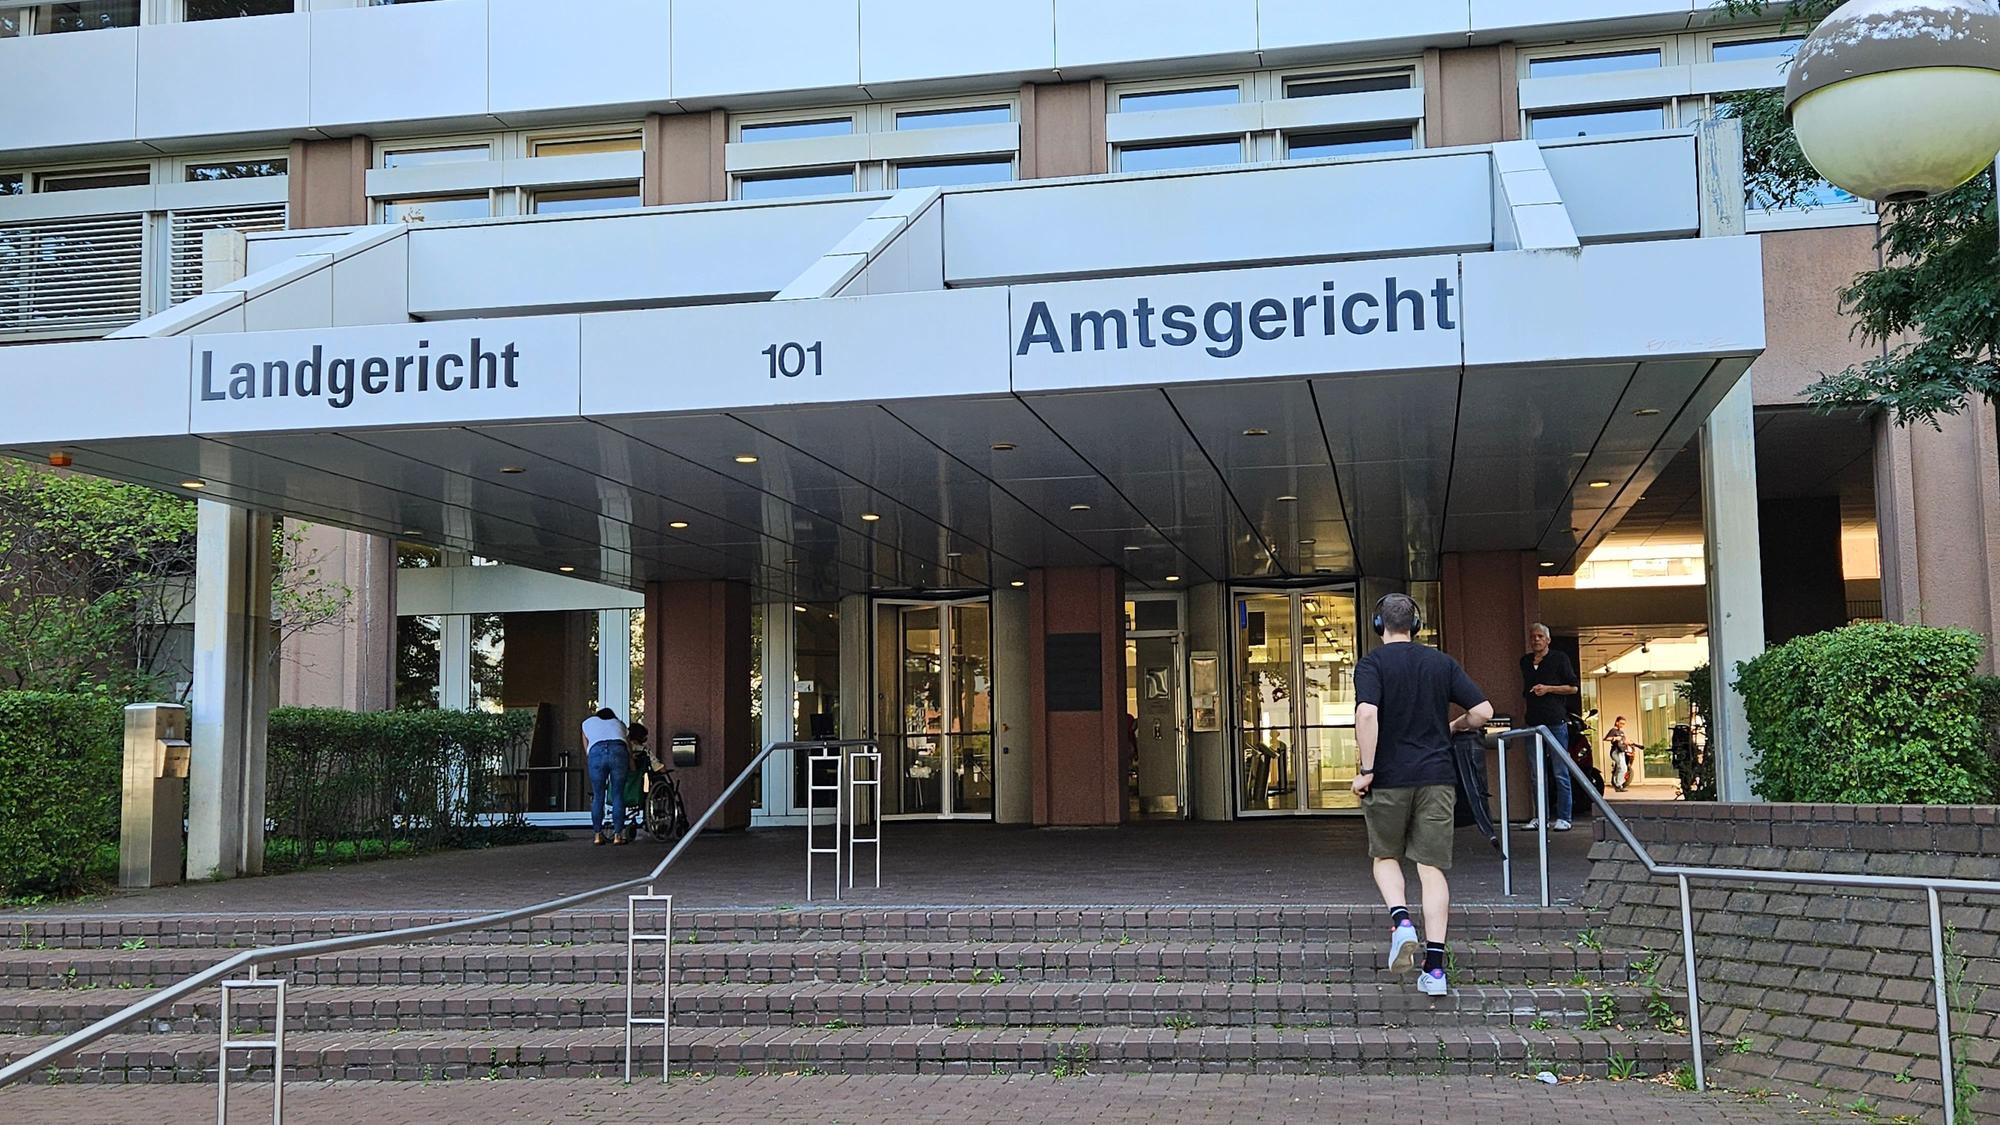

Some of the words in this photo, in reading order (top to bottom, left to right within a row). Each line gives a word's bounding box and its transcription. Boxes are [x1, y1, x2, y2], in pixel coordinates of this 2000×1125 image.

[1015, 276, 1456, 359] Amtsgericht
[201, 337, 520, 409] Landgericht
[761, 340, 822, 379] 101
